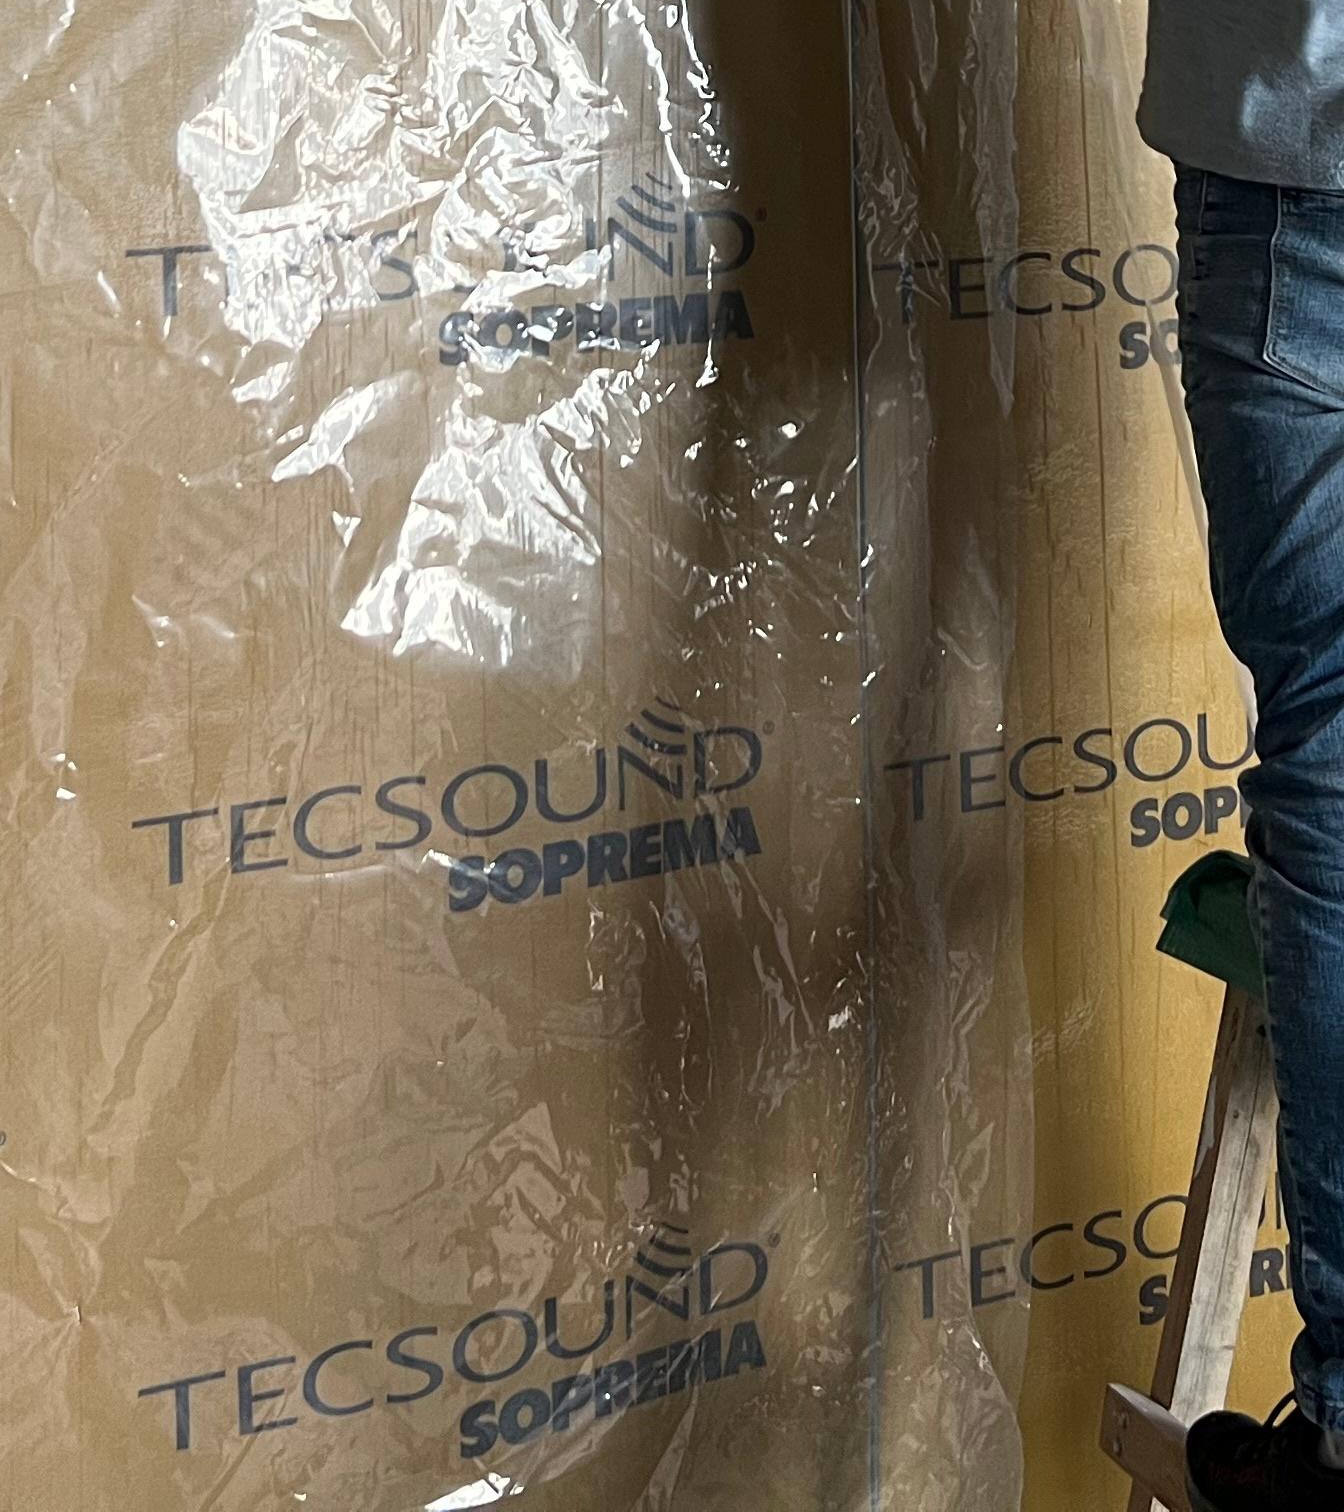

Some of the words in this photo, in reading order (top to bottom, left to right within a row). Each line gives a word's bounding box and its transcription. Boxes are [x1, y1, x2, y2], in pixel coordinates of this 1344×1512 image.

[438, 291, 755, 365] SOPREMA
[132, 723, 763, 885] TECSOUND
[448, 807, 762, 915] SOPREMA
[138, 1241, 769, 1451] TECSOUND
[459, 1320, 767, 1459] SOPREMA
